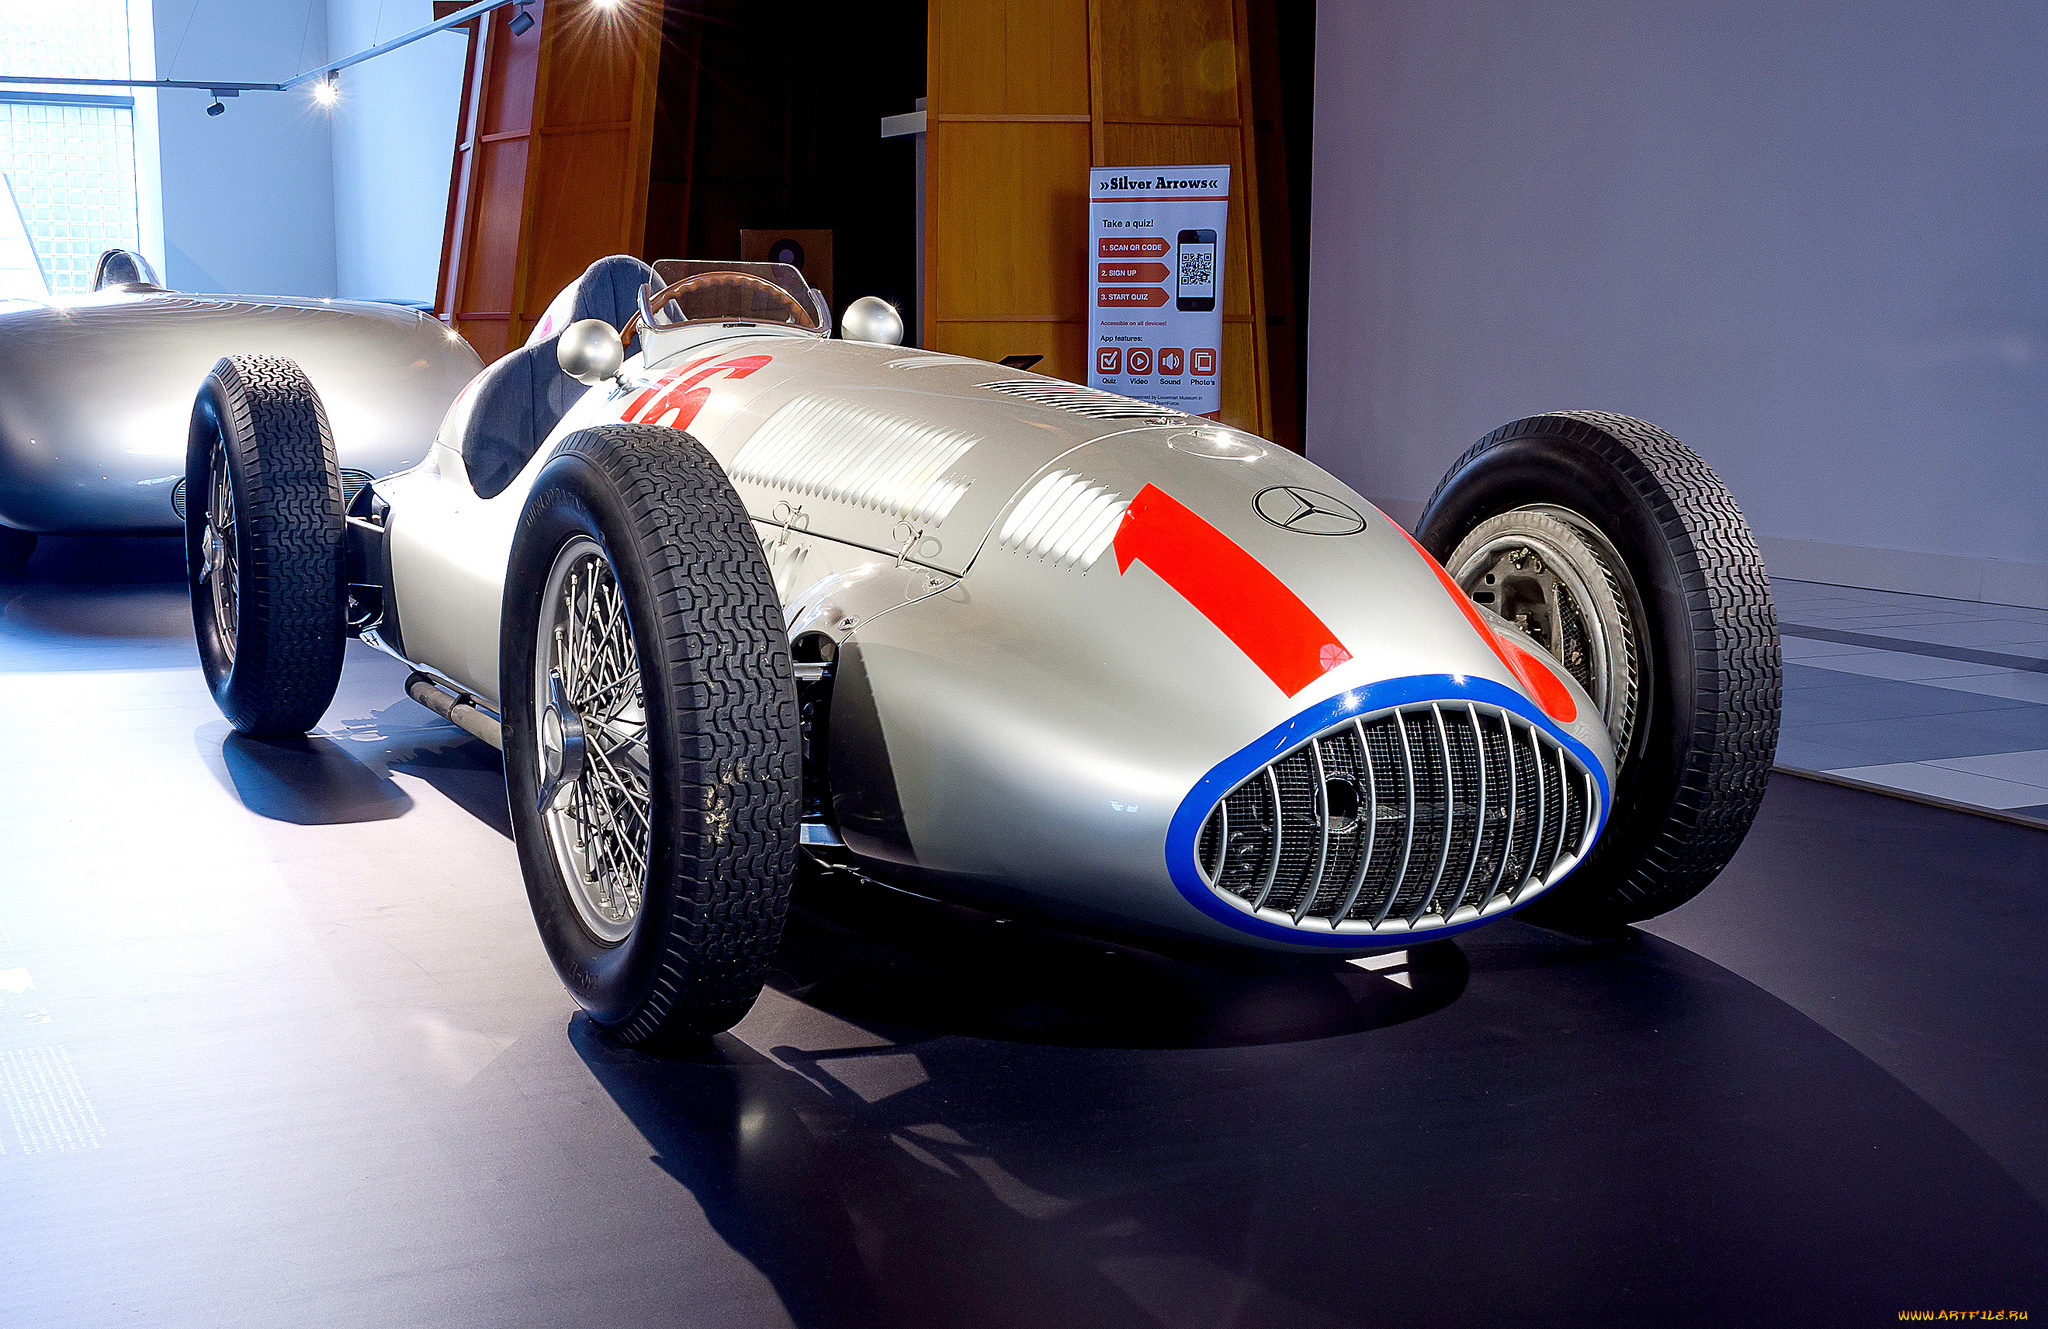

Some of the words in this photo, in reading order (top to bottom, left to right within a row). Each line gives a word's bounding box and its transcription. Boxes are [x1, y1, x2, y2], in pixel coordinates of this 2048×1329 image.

[1102, 219, 1122, 228] Take
[1132, 219, 1154, 229] quiz!
[1101, 269, 1108, 277] 2.
[1108, 269, 1126, 277] SIGN
[1100, 335, 1114, 343] App
[1102, 377, 1117, 385] Quiz
